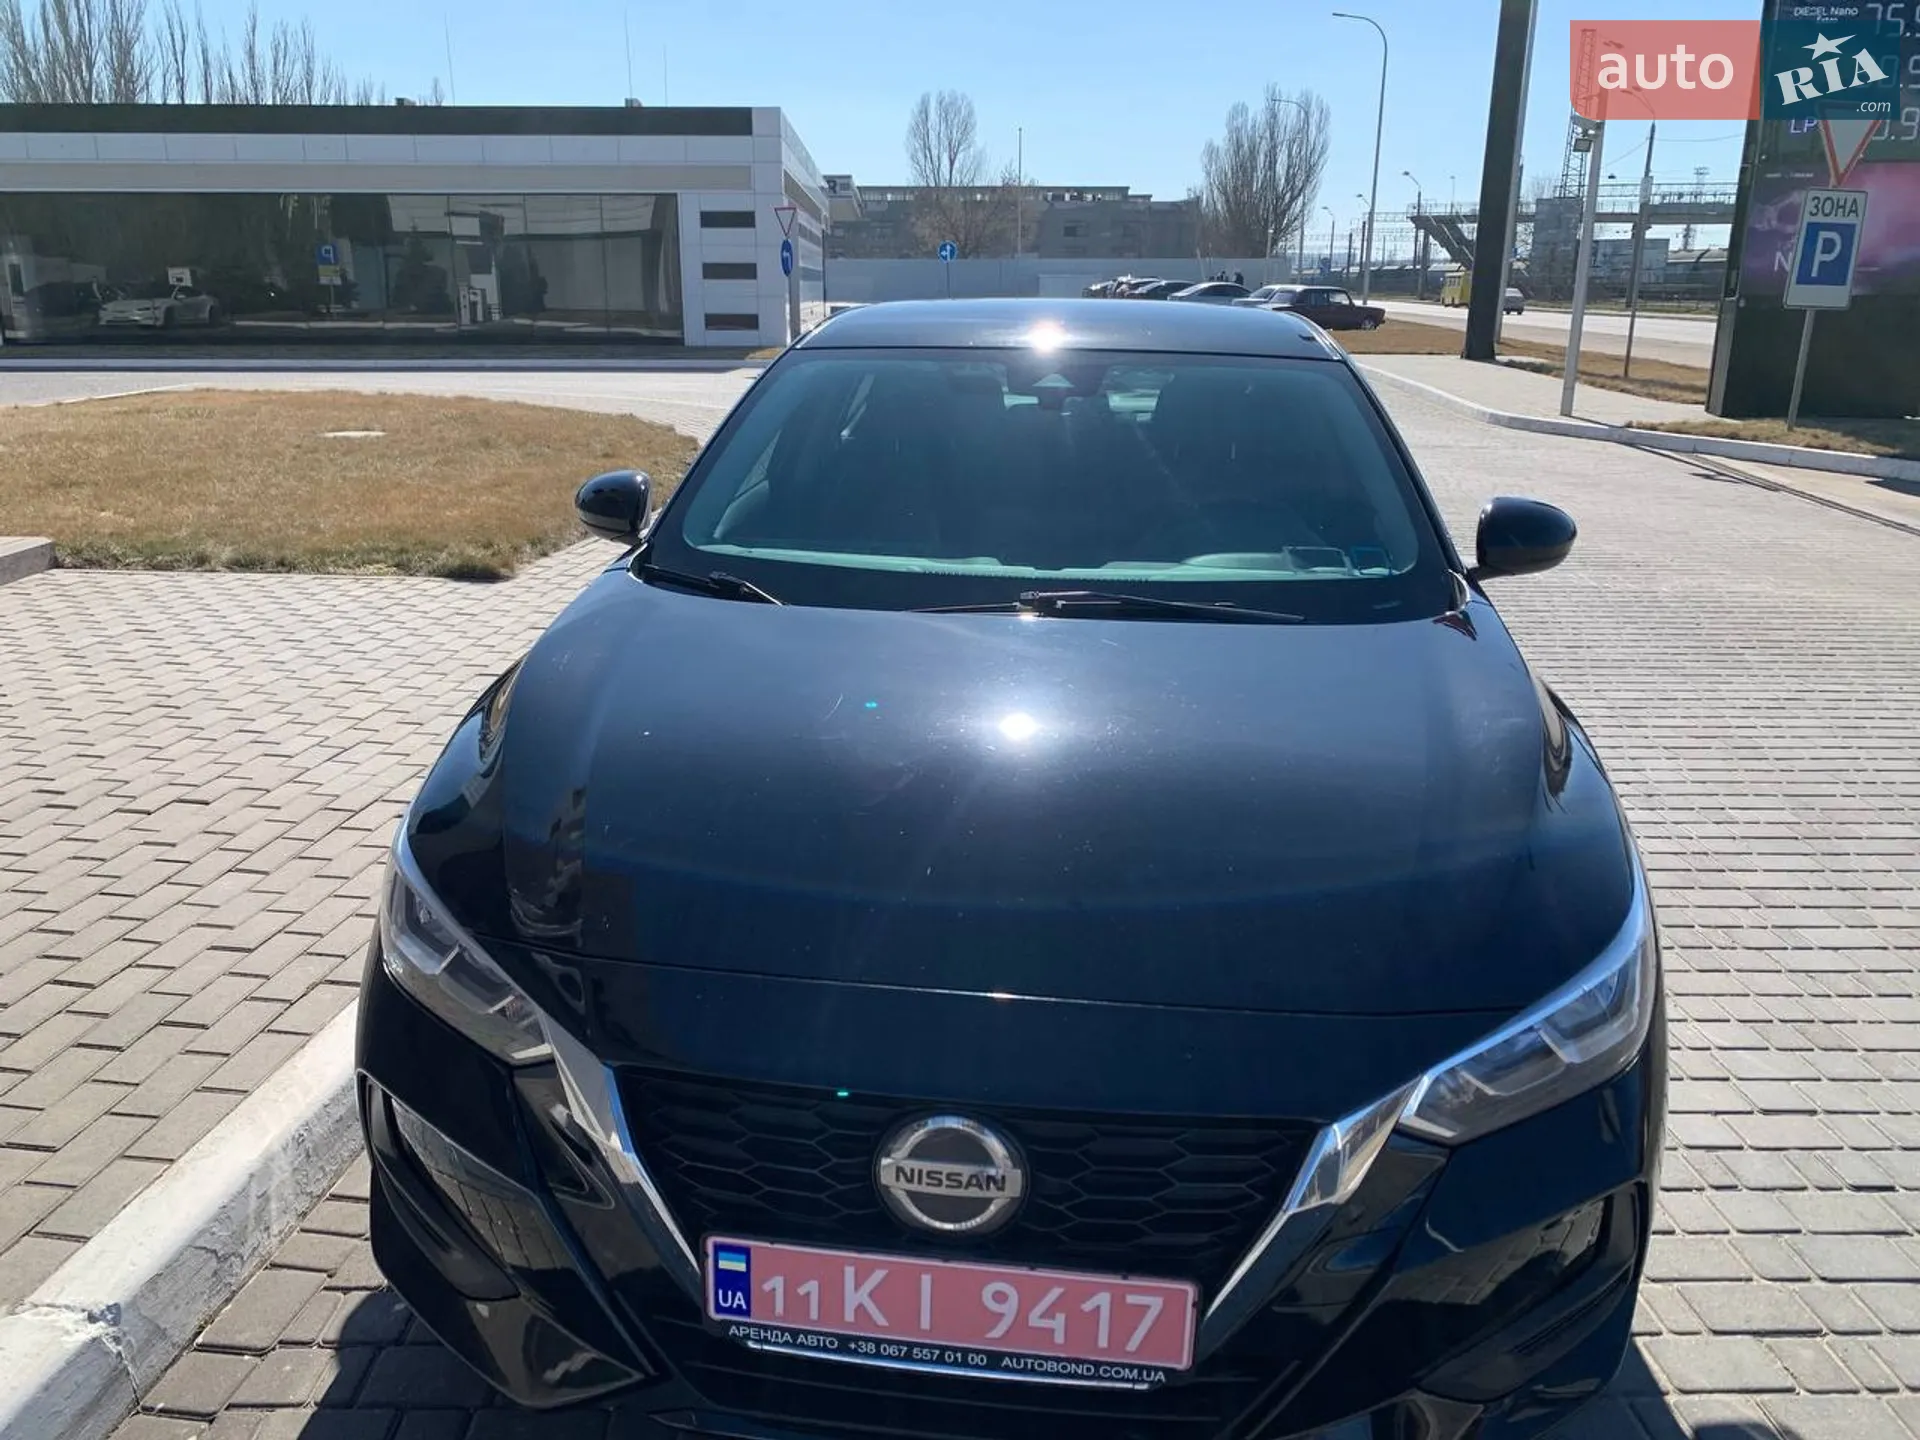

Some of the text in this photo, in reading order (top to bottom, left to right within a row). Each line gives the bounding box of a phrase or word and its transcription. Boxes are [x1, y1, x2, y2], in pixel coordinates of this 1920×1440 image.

[1809, 196, 1859, 217] ЗОНА
[1811, 230, 1842, 277] P
[895, 1165, 1006, 1192] NISSAN
[718, 1289, 747, 1309] UA
[981, 1282, 1165, 1352] 9417
[729, 1325, 1166, 1383] АРЕНДА АВТО +38 067 557 01 00 AUTOBOND.COM.UA
